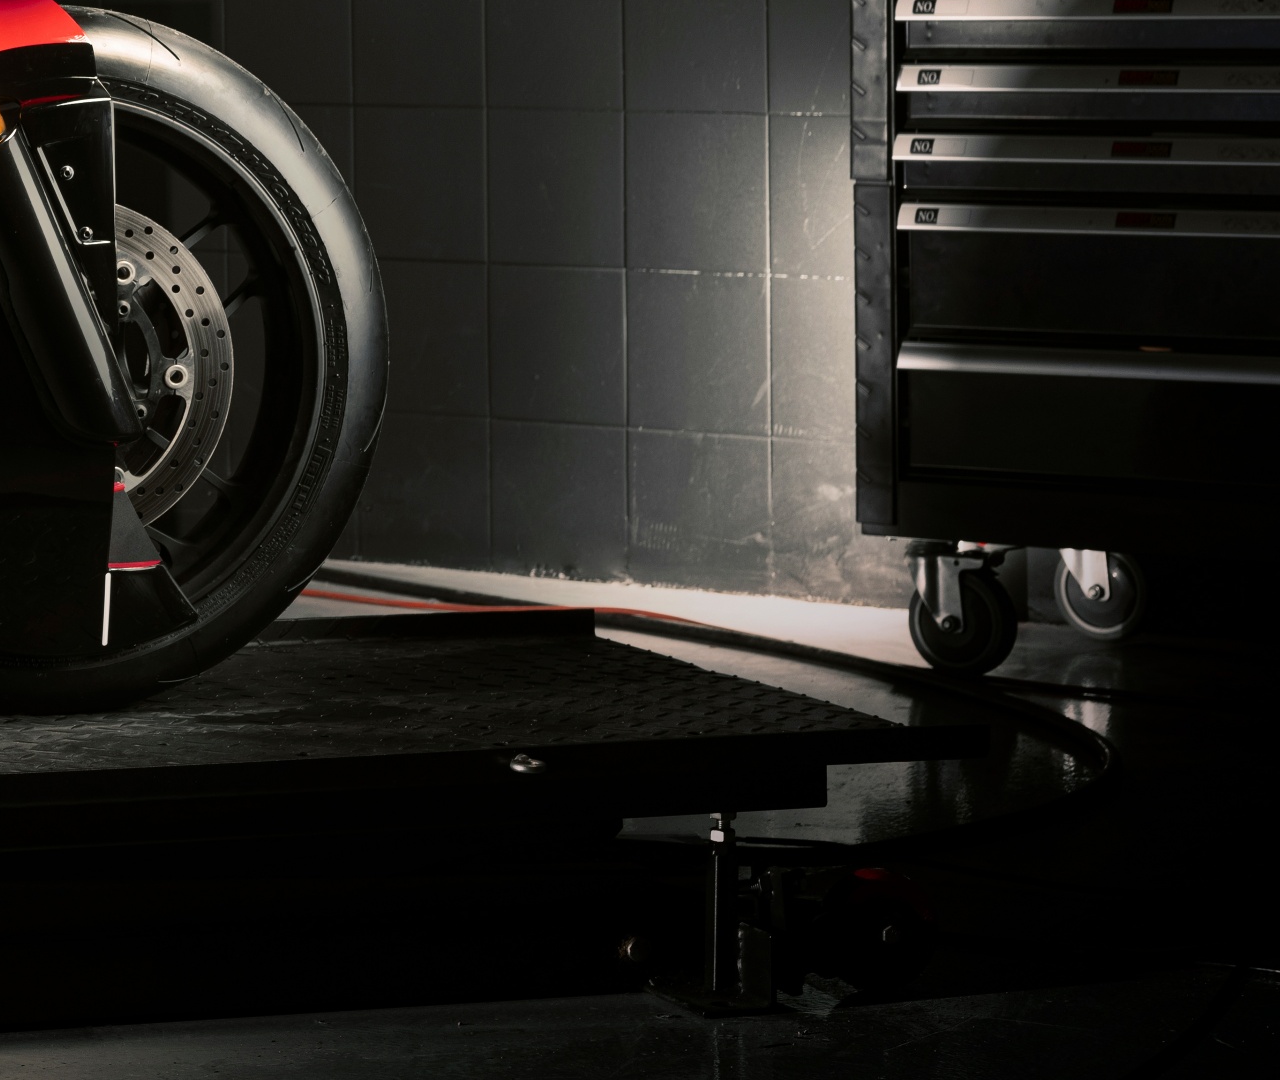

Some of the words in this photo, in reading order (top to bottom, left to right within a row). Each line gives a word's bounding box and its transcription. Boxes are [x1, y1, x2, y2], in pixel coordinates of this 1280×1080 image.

[913, 0, 935, 13] NO.
[919, 71, 940, 84] NO.
[911, 140, 933, 153] NO.
[916, 209, 938, 223] NO.
